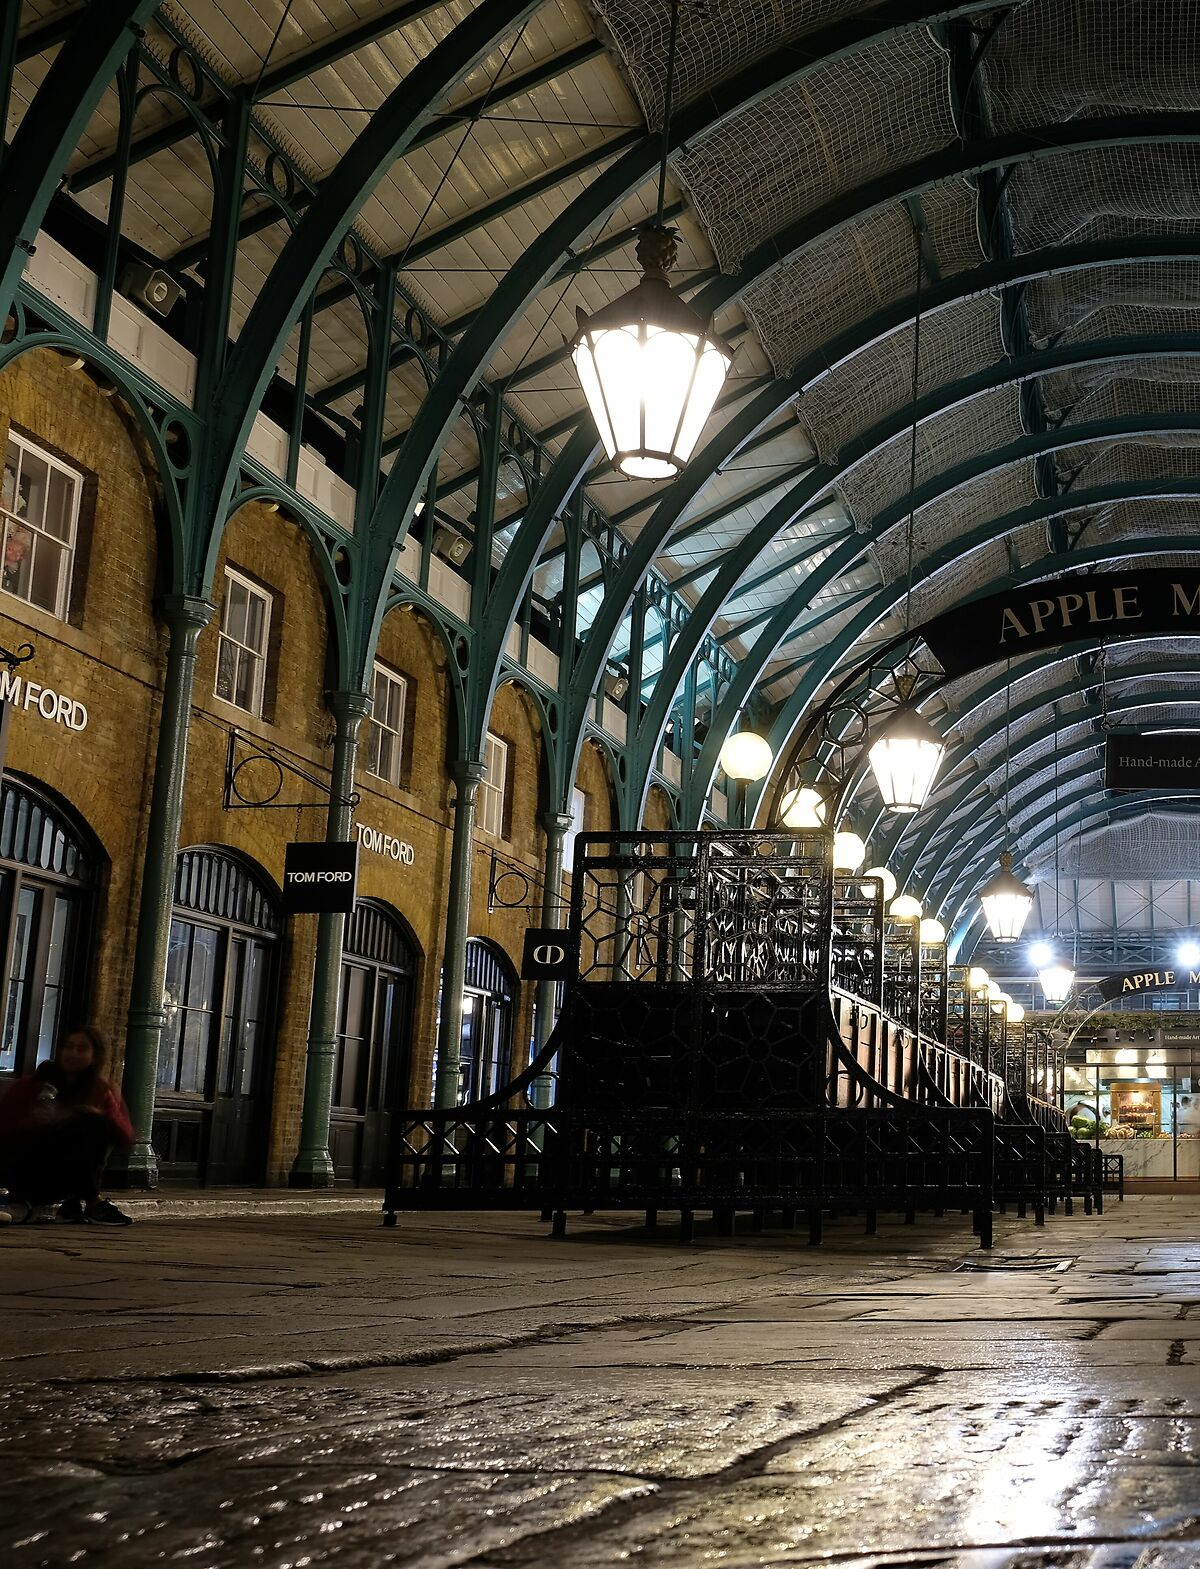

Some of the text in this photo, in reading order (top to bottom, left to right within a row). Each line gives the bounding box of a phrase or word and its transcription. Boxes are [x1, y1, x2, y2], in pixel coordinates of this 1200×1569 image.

[1000, 586, 1143, 643] APPLE
[23, 681, 88, 731] FORD
[1119, 756, 1192, 769] Hand-made
[355, 822, 415, 866] TOM FORD
[287, 871, 352, 883] TOM FORD
[1122, 971, 1176, 992] APPLE
